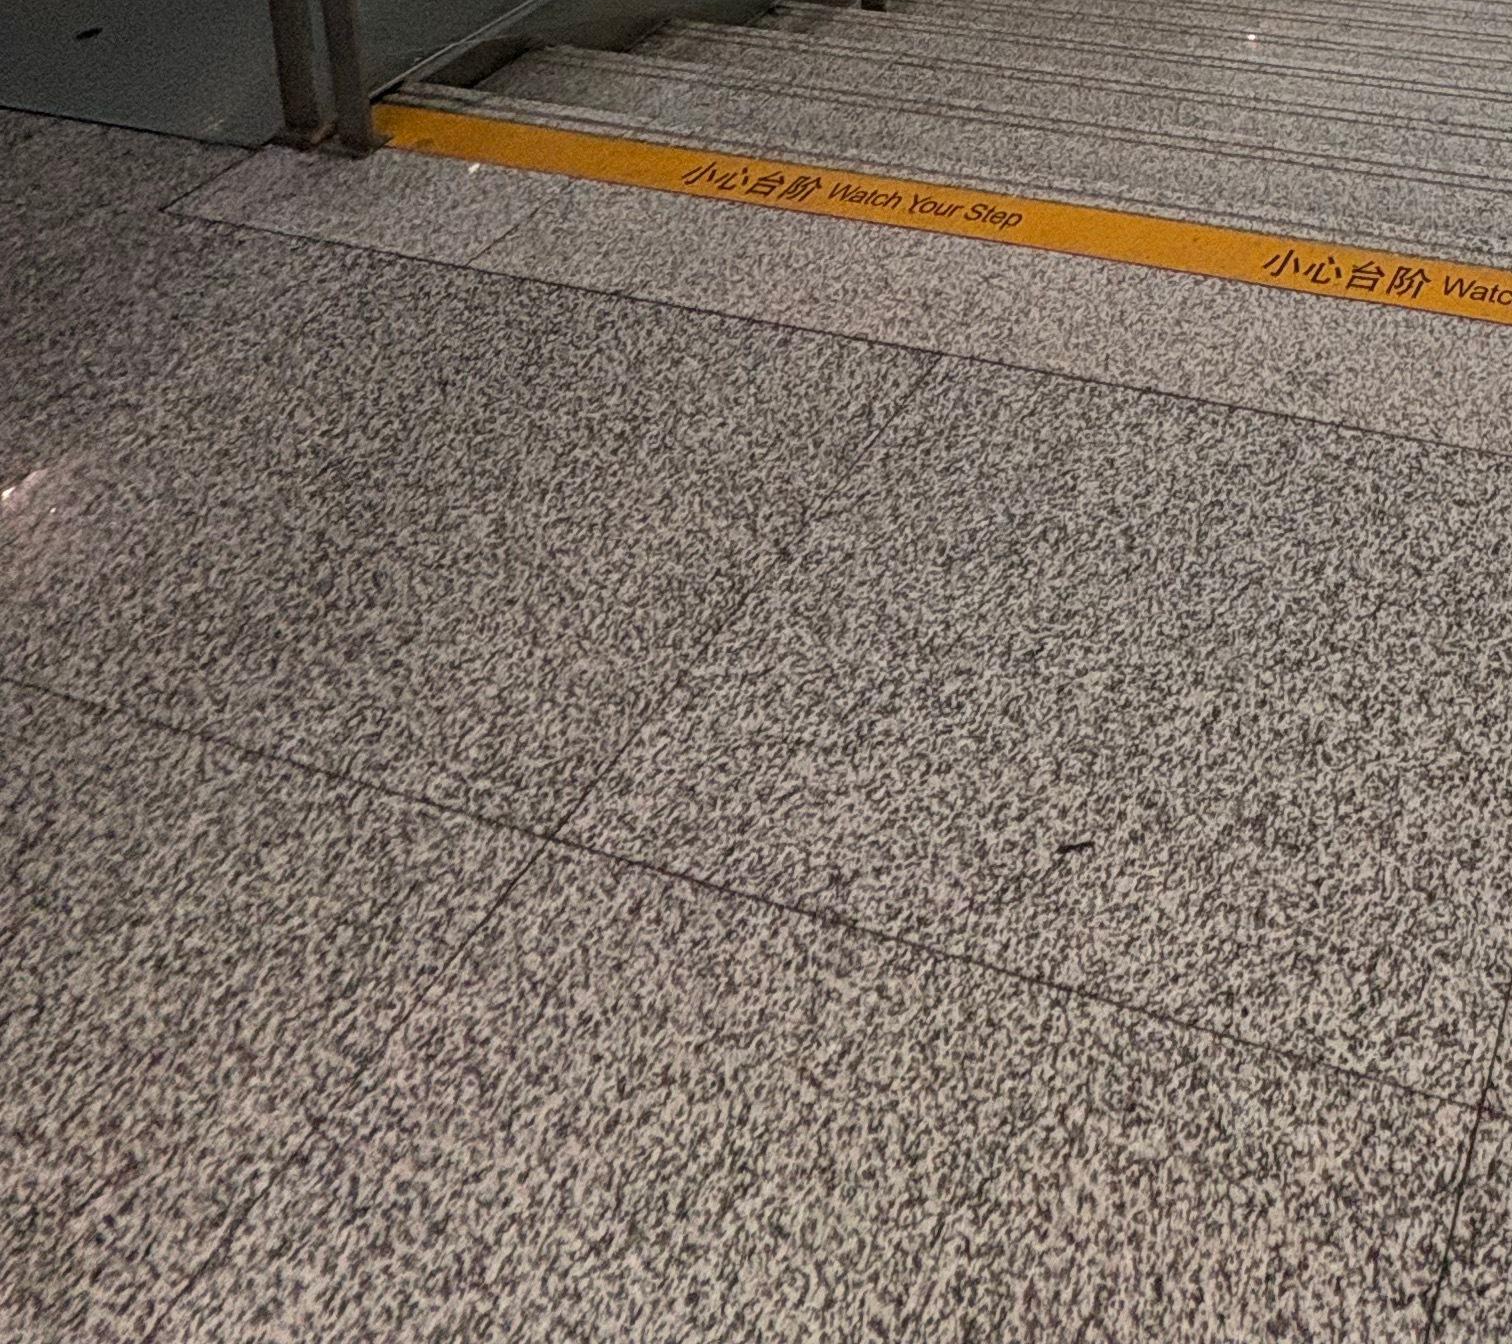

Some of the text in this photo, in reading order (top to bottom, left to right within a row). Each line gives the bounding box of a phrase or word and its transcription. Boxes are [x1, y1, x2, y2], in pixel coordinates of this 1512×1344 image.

[681, 161, 1023, 230] 小心台阶 Watch Your Step
[1263, 249, 1432, 300] 小心台阶
